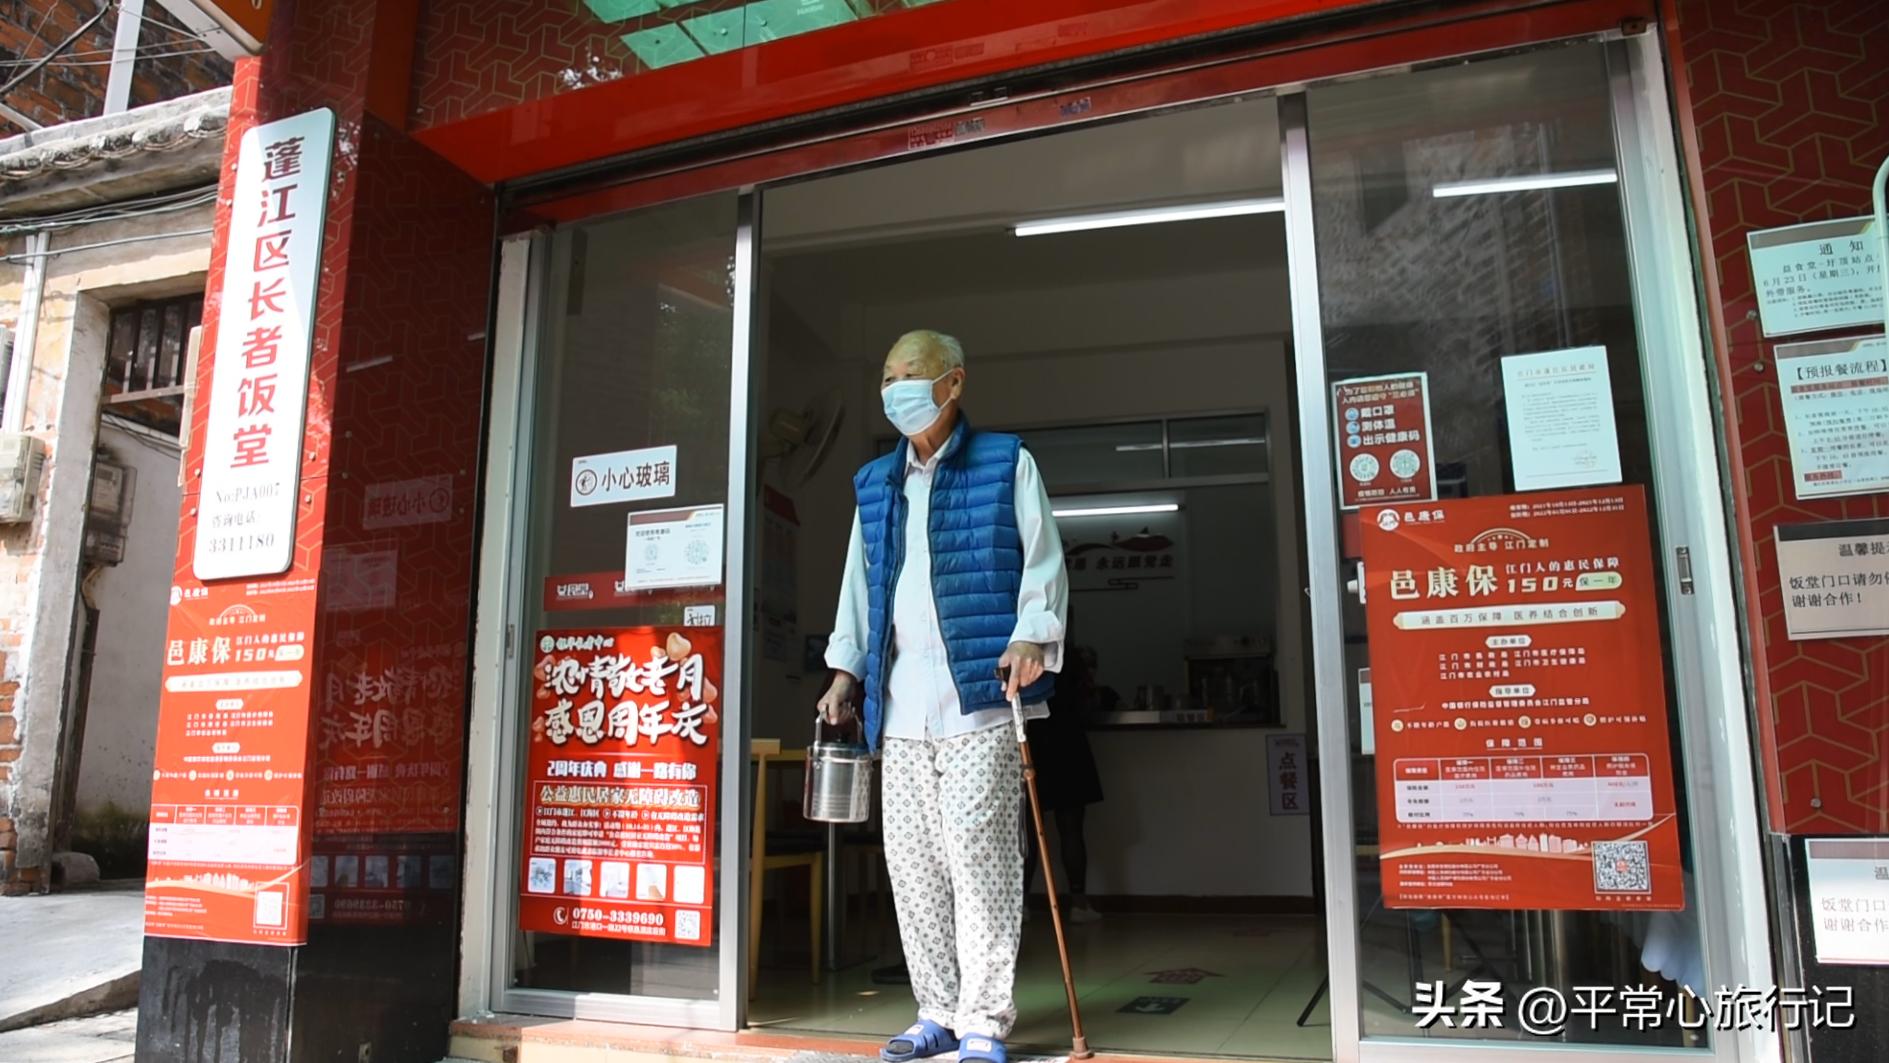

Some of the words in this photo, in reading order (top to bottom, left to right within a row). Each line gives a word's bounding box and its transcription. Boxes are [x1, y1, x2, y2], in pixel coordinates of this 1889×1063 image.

[1819, 240, 1864, 256] 通知
[230, 136, 304, 469] 蓬江区长者饭堂
[1796, 359, 1888, 380] 【预报餐流程】
[1363, 430, 1420, 446] 出示健康码
[601, 460, 671, 492] 小心玻璃
[1403, 509, 1446, 523] 邑康保
[1504, 538, 1549, 551] 江门定制
[1838, 541, 1889, 557] 温馨提
[1505, 556, 1620, 575] 江门人的惠民保障
[1390, 563, 1498, 600] 邑康保
[1507, 576, 1574, 594] 150元
[1792, 592, 1863, 608] 谢谢合作！
[1421, 611, 1502, 625] 涵盖百万保障
[1514, 607, 1598, 621] 医养结合创新
[167, 635, 232, 666] 邑康保
[544, 698, 709, 745] 感恩周年庆
[547, 760, 607, 778] 2周年庆典
[613, 761, 697, 780] 感谢一路有你
[1279, 751, 1299, 811] 点餐区
[540, 785, 700, 808] 公益惠民居家无障碍改造
[572, 907, 664, 926] 0750-3339690
